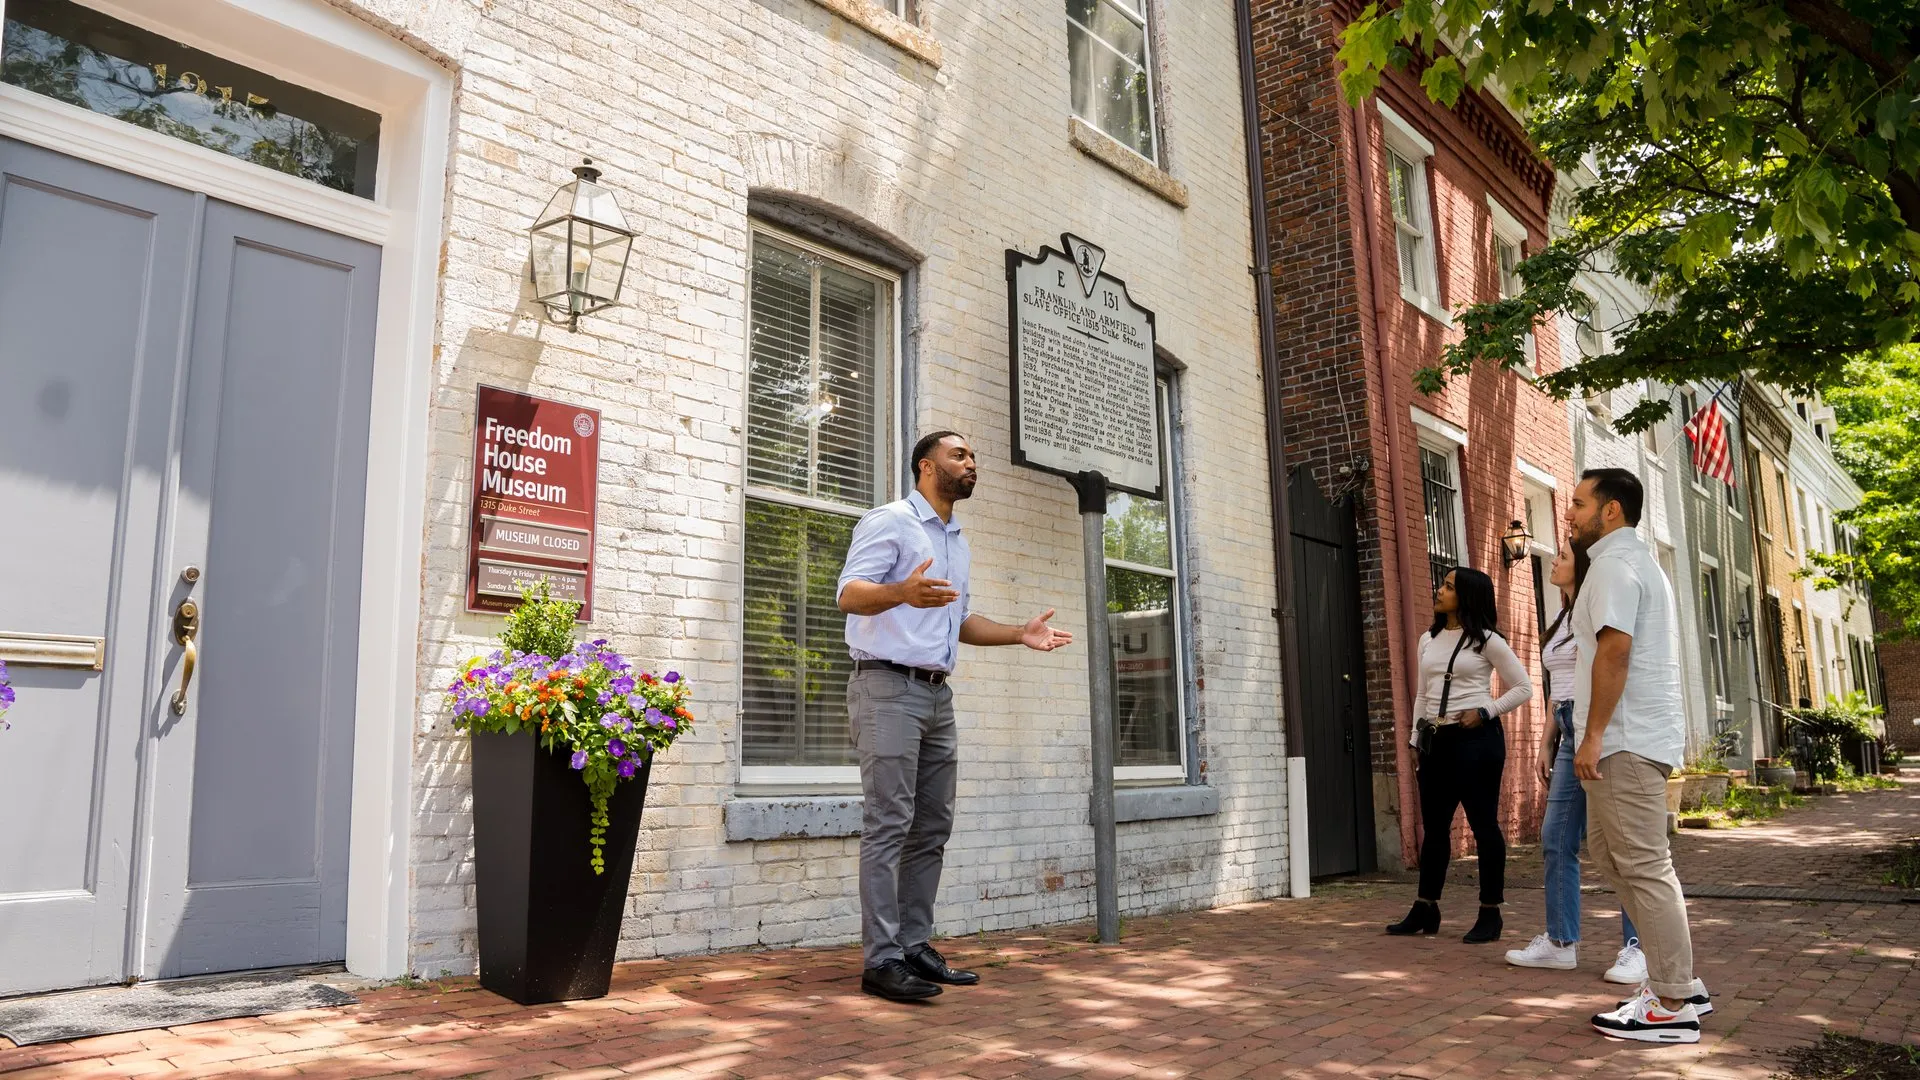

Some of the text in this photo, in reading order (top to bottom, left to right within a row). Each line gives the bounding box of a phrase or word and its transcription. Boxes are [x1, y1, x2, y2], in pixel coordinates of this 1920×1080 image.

[1057, 269, 1119, 311] E 131
[1023, 293, 1147, 350] SLAVE OFFICE (1315 Duke Street)
[1034, 286, 1137, 337] FRANKLIN AND ARMFIELD
[1021, 316, 1147, 372] Isaac Franklin and John Armfield leased this brick
[1022, 326, 1045, 342] building
[1047, 335, 1060, 346] with
[1062, 342, 1079, 353] access
[1090, 352, 1098, 360] the
[1101, 355, 1120, 368] wharves
[1123, 365, 1132, 373] and
[1135, 369, 1148, 379] docks
[1022, 334, 1027, 342] in
[1031, 337, 1044, 348] 1828
[1063, 349, 1083, 364] holding
[1086, 359, 1096, 368] pen
[1098, 362, 1106, 371] for
[1108, 367, 1130, 380] enslaved
[1132, 376, 1148, 388] people
[1022, 343, 1038, 356] being
[1039, 349, 1060, 363] shipped
[1061, 357, 1074, 367] from
[1075, 362, 1098, 376] Northern
[1099, 371, 1118, 385] Virginia
[1023, 352, 1037, 364] They
[1041, 359, 1069, 374] purchased
[1072, 370, 1081, 378] the
[1084, 374, 1104, 388] building
[1107, 382, 1116, 391] and
[1044, 367, 1059, 379] From
[1064, 375, 1074, 384] this
[1079, 380, 1100, 393] location
[1105, 390, 1127, 402] Armfield
[1133, 399, 1150, 412] bought
[1023, 369, 1058, 388] bondspeople
[1067, 384, 1076, 393] low
[1078, 388, 1094, 399] prices
[1095, 394, 1104, 402] and
[1105, 398, 1125, 411] shipped
[1126, 404, 1138, 414] them
[1138, 409, 1150, 418] south
[1023, 387, 1034, 396] and
[1035, 390, 1047, 401] New
[1117, 417, 1127, 426] sold
[1135, 423, 1151, 435] higher
[1032, 381, 1040, 390] his
[1043, 385, 1064, 398] partner
[1093, 401, 1099, 409] in
[485, 416, 572, 455] Freedom
[1023, 405, 1042, 417] people
[1071, 420, 1098, 435] operating
[1117, 433, 1123, 441] of
[1125, 436, 1133, 444] the
[1136, 439, 1152, 451] largest
[1024, 414, 1152, 457] slave-trading companies in the United States
[1048, 403, 1055, 413] By
[1059, 407, 1068, 416] the
[1072, 410, 1088, 422] 1830s
[1091, 417, 1103, 427] they
[1107, 422, 1120, 432] often
[1124, 427, 1134, 436] sold
[483, 442, 547, 475] House
[1024, 432, 1050, 446] property
[1053, 440, 1066, 449] until
[1024, 422, 1037, 432] until
[1055, 431, 1069, 442] Slave
[1071, 437, 1091, 448] traders
[1093, 444, 1126, 458] continuously
[1127, 454, 1143, 463] owned
[482, 468, 566, 504] Museum
[480, 499, 540, 517] 1315 Duke Street
[495, 529, 580, 551] MUSEUM CLOSED
[487, 582, 507, 592] Sunday
[488, 566, 512, 577] Thursday
[519, 570, 535, 580] Friday
[481, 599, 503, 607] Museum
